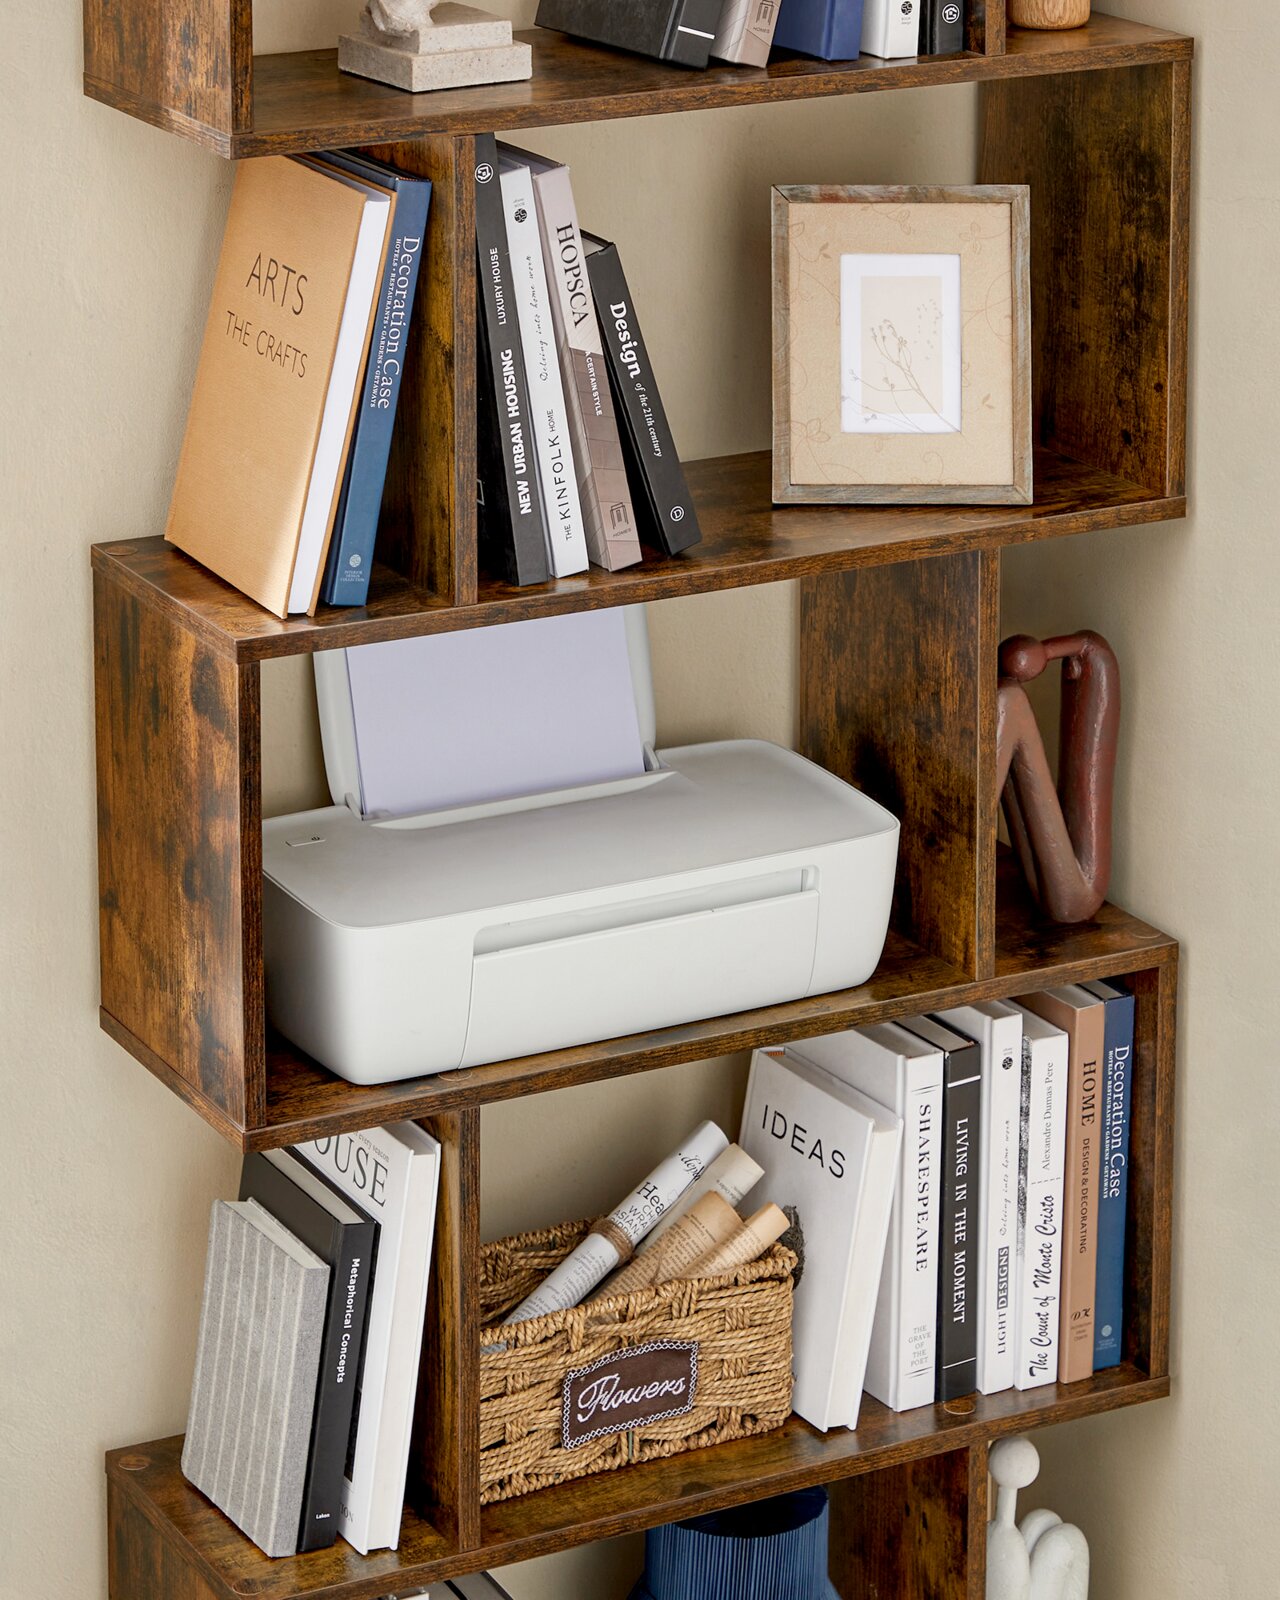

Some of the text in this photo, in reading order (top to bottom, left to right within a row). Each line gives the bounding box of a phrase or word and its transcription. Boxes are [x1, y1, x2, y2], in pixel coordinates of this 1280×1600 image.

[246, 252, 308, 315] ARTS
[370, 238, 402, 408] HOTELS RESTAURANTS GARDENS GETAWAYS
[378, 236, 420, 409] Decoration Case
[490, 247, 507, 325] LUXURY HOUSE
[556, 222, 589, 329] HOPSCA
[226, 310, 308, 378] THE CRAFTS
[586, 357, 598, 392] CERTAIN
[592, 391, 603, 417] STYLE
[610, 301, 663, 458] Design of the 21th century
[500, 349, 532, 515] NEW URBAN HOUSING
[546, 409, 572, 541] THE KINFOLK HOME
[762, 1104, 846, 1179] IDEAS
[1042, 1062, 1054, 1171] Alexandre Dumas Pere
[1079, 1060, 1097, 1254] HOME DESIGN & DECORATING
[1109, 1044, 1130, 1198] Decoration Case
[916, 1104, 932, 1272] SHAKESPEARE
[953, 1117, 969, 1324] LIVING IN THE MOMENT
[336, 1258, 361, 1383] Metaphorical Concepts
[908, 1331, 931, 1343] GRAVE
[913, 1325, 927, 1334] THE
[998, 1246, 1009, 1354] LIGHT DESIGNS
[1029, 1195, 1057, 1377] The Count of Monte Cristo
[577, 1373, 686, 1422] Flowers
[910, 1356, 928, 1367] POET
[912, 1350, 927, 1358] THE
[914, 1341, 925, 1349] OF
